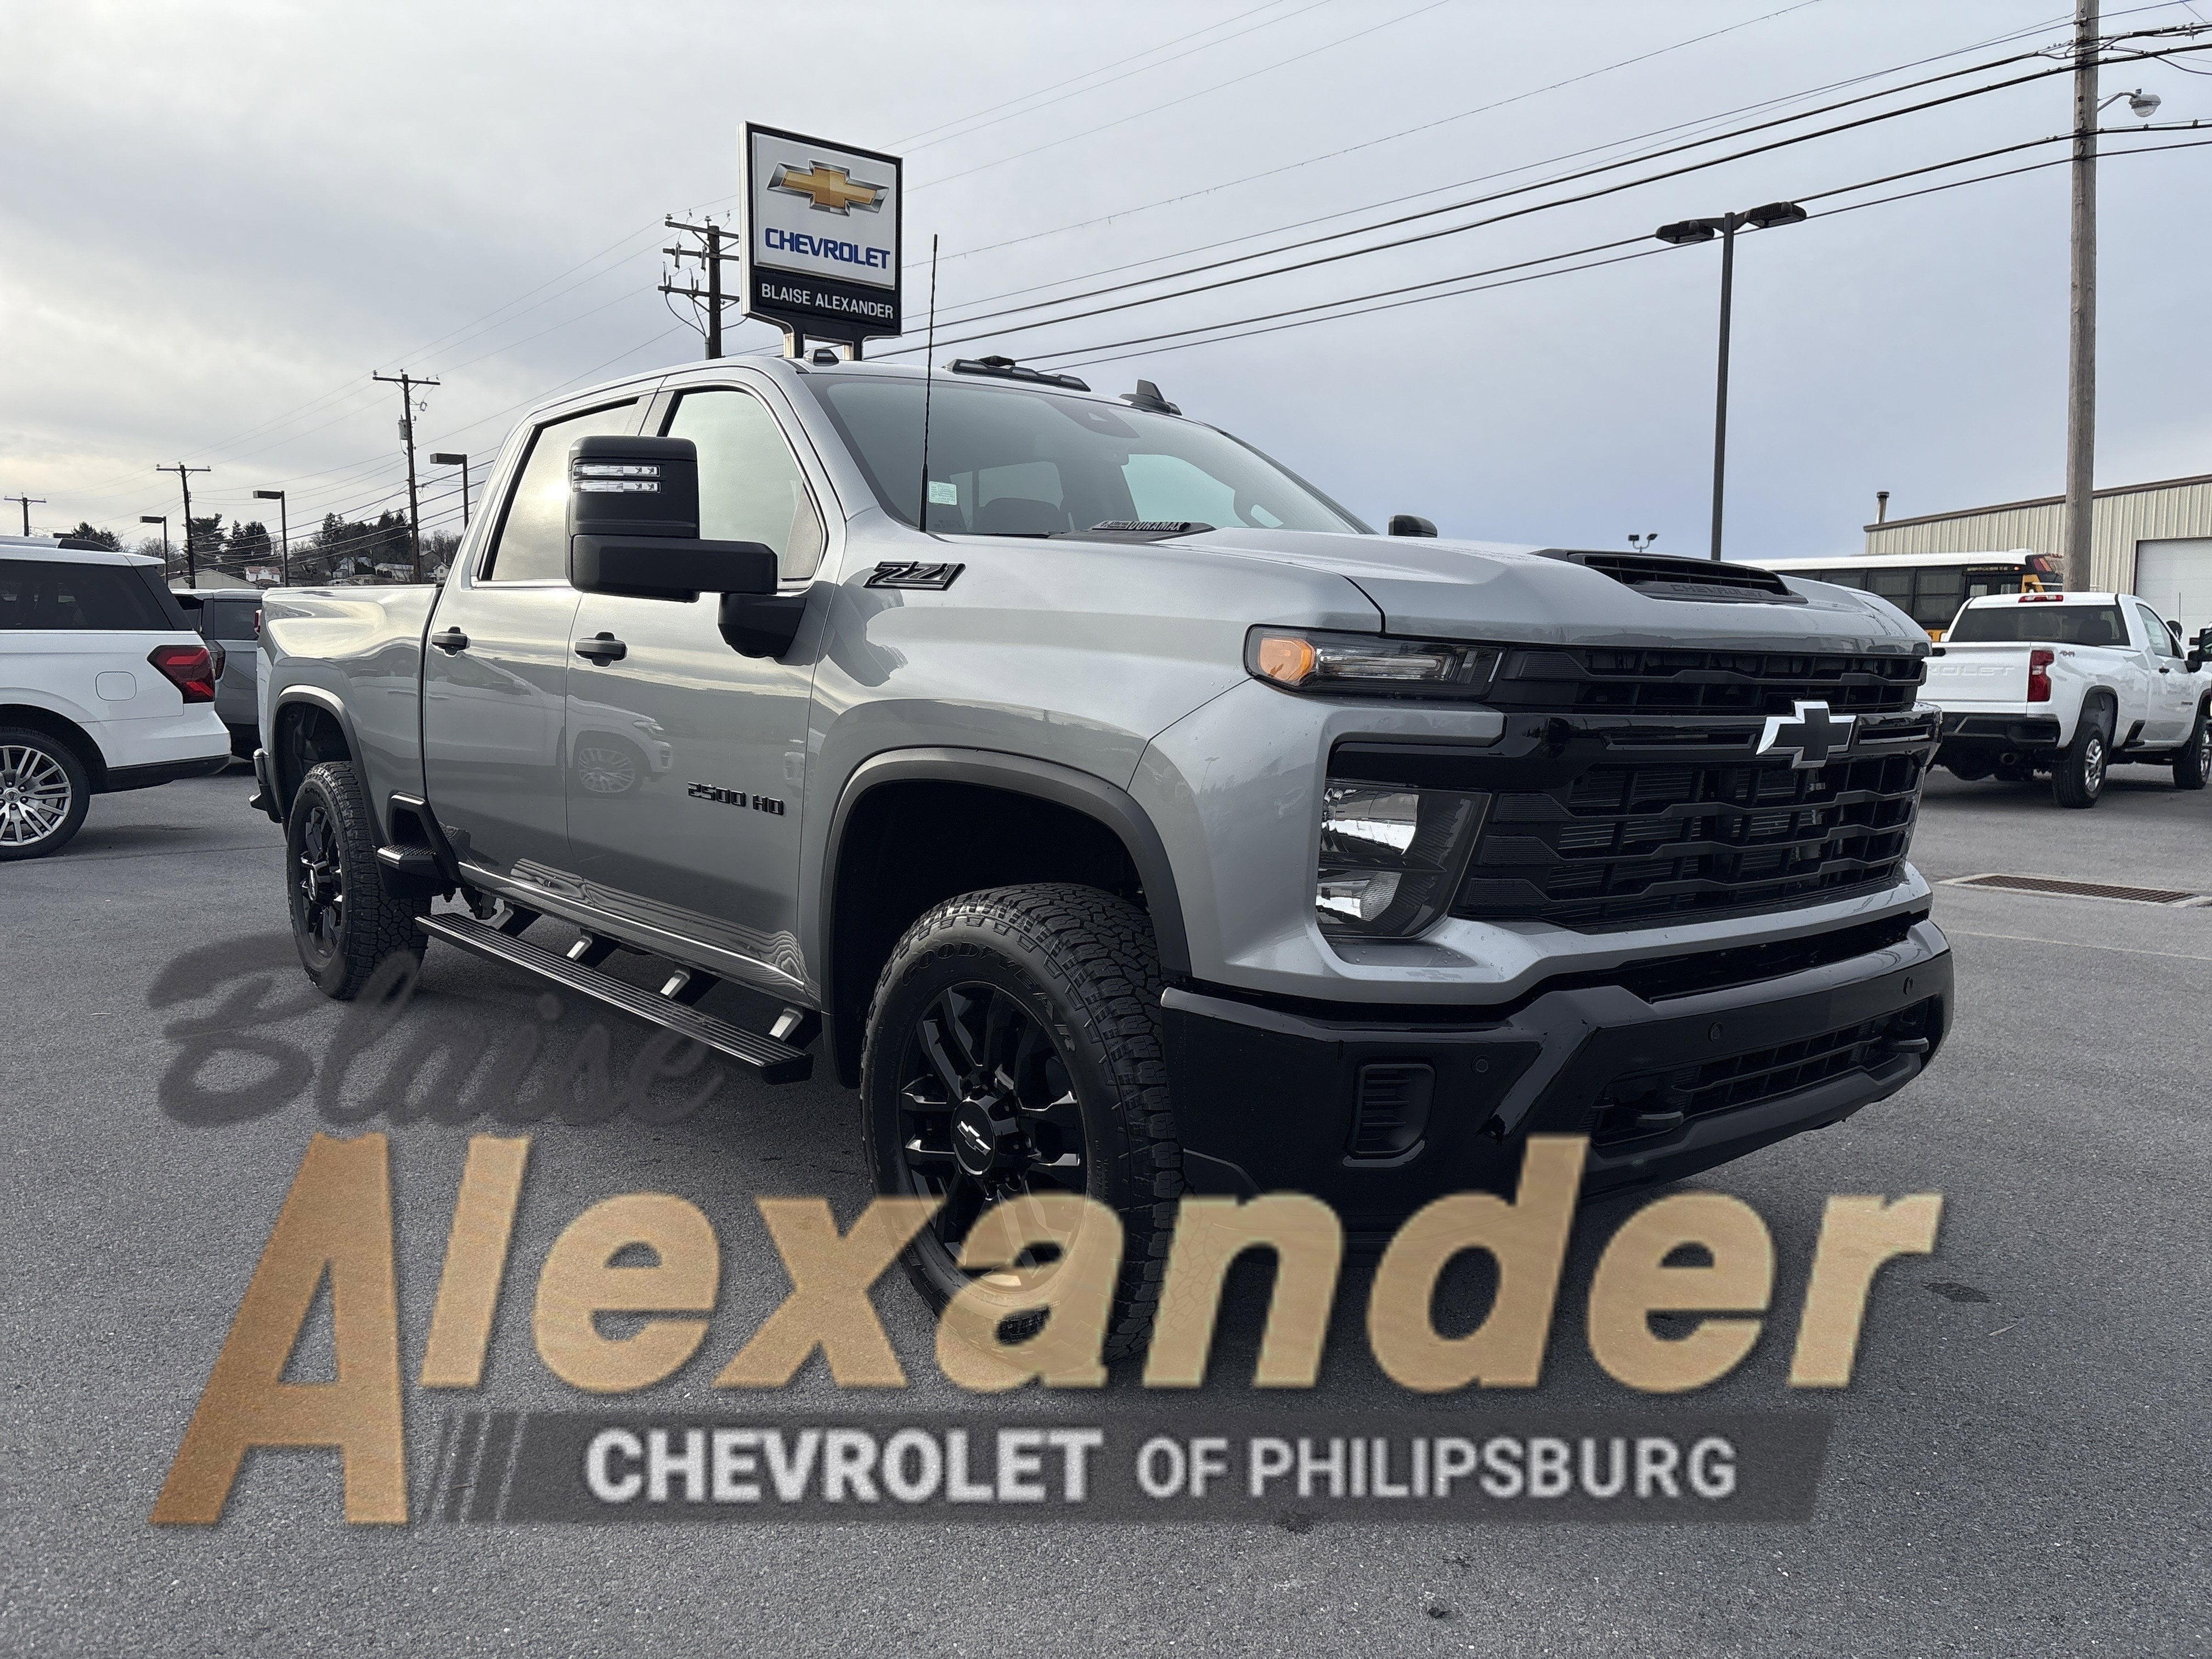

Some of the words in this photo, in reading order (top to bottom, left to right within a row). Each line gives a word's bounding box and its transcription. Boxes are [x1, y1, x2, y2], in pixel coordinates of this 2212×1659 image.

[765, 228, 890, 269] CHEVROLET
[761, 283, 811, 305] BLAISE
[815, 293, 894, 319] ALEXANDER
[1128, 521, 1183, 531] DURAMAX
[1670, 584, 1762, 598] CHEVROLET
[687, 781, 746, 807] 2500
[752, 794, 784, 816] HD
[902, 941, 1076, 1052] GOODYEAR
